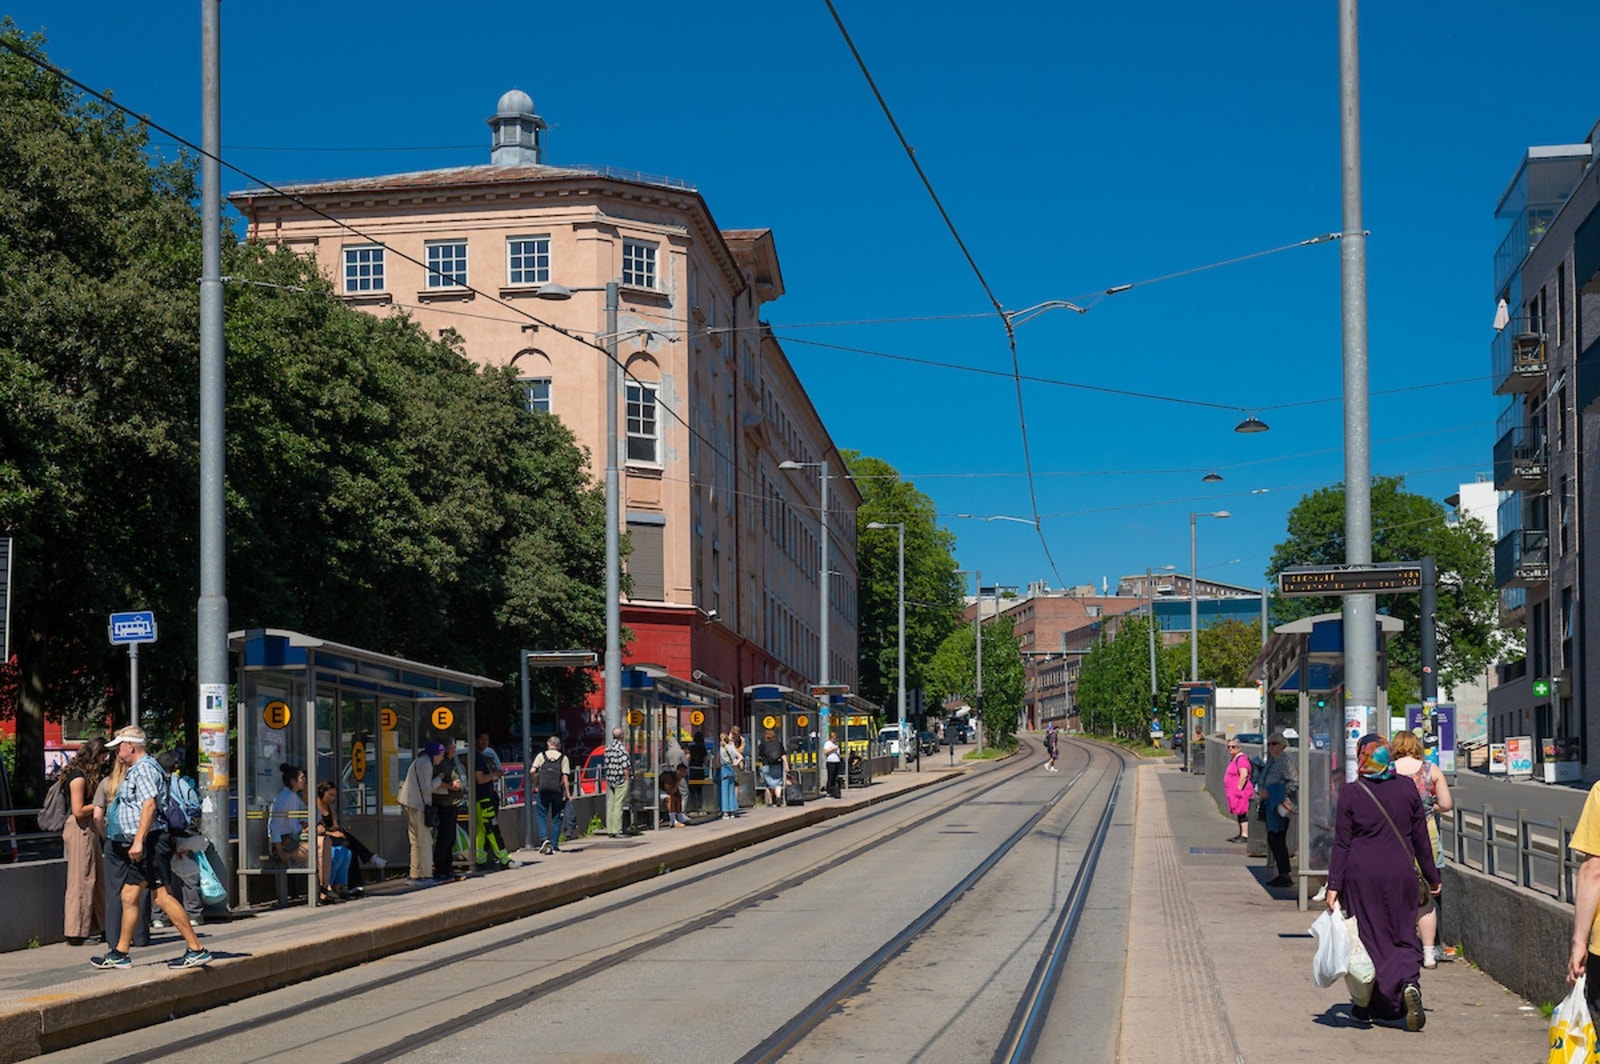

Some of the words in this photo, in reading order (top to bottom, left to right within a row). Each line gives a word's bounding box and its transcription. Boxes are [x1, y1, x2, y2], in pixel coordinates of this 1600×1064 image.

[272, 707, 282, 723] E
[439, 712, 447, 725] E
[694, 713, 700, 723] E
